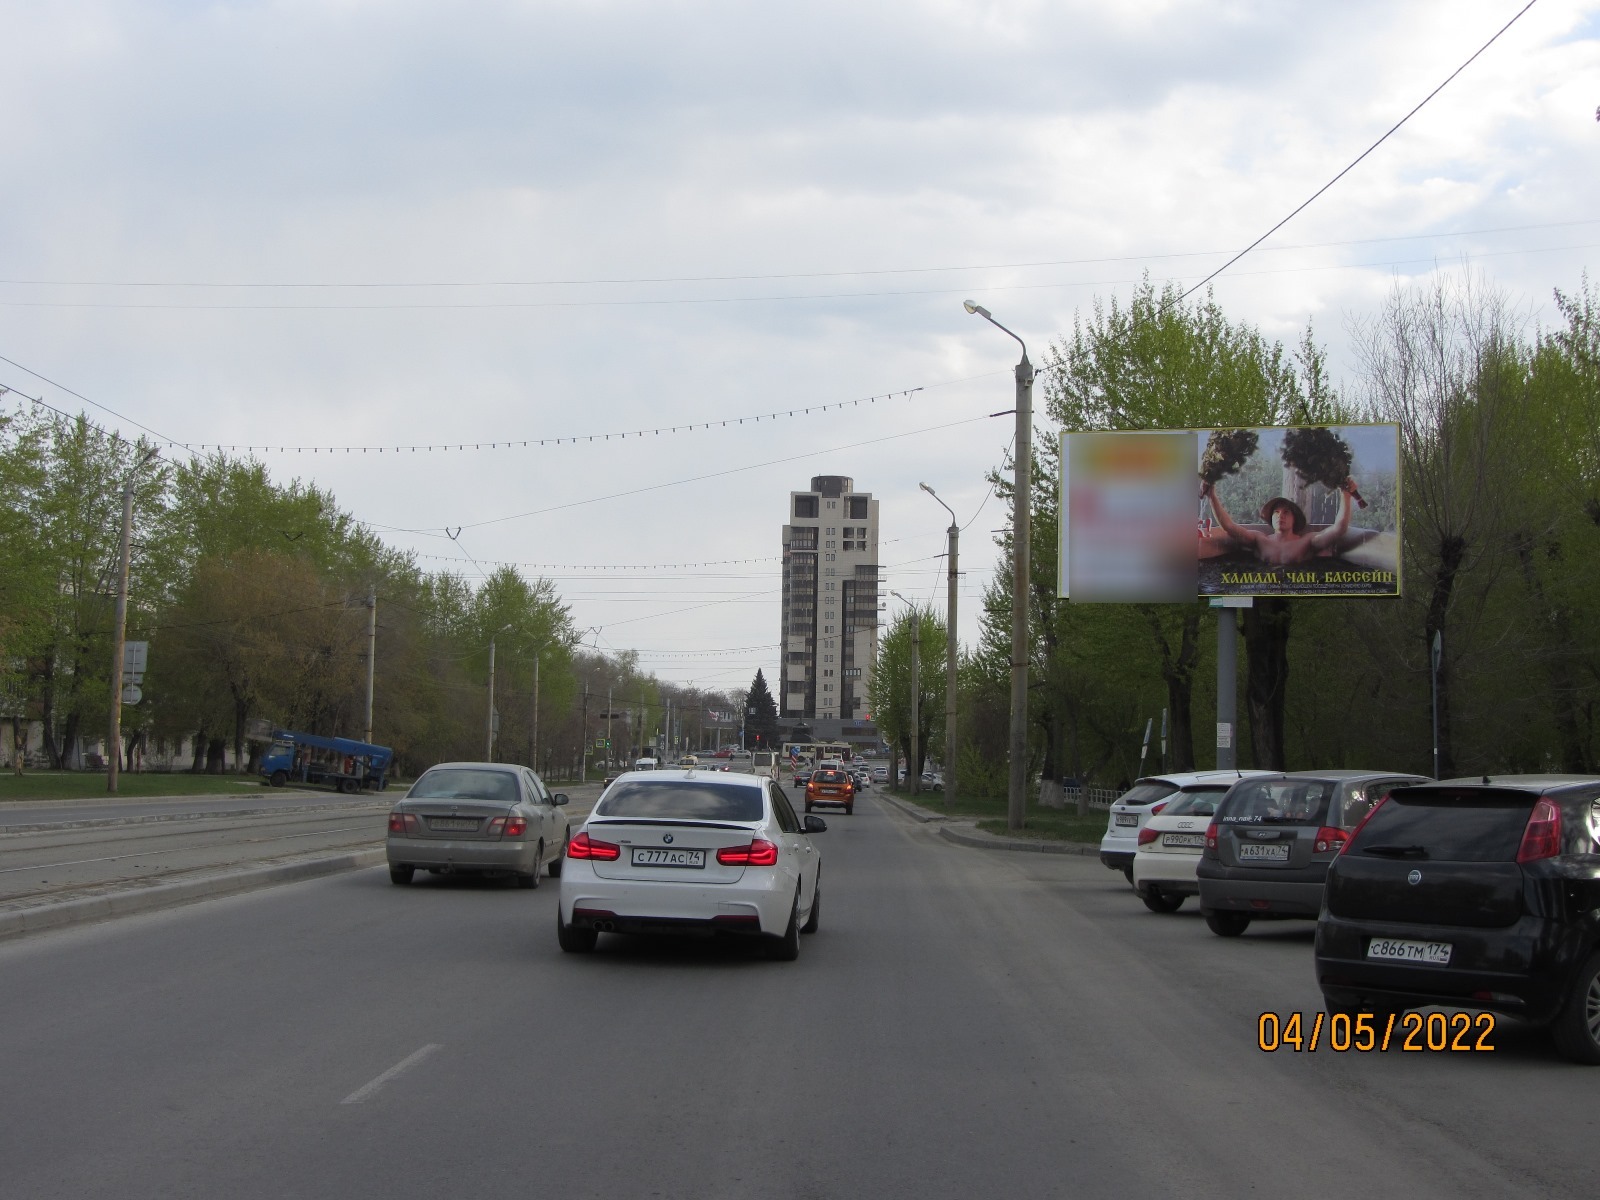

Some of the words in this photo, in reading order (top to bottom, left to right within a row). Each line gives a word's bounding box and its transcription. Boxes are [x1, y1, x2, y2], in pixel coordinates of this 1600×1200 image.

[1221, 572, 1281, 585] ХАМАМ,
[1286, 571, 1319, 585] ЧАН,
[1325, 569, 1392, 583] БАССЕЙН
[638, 850, 685, 863] С777АС
[688, 851, 700, 861] 74
[1372, 941, 1424, 959] С866ТМ
[1427, 943, 1448, 957] 174
